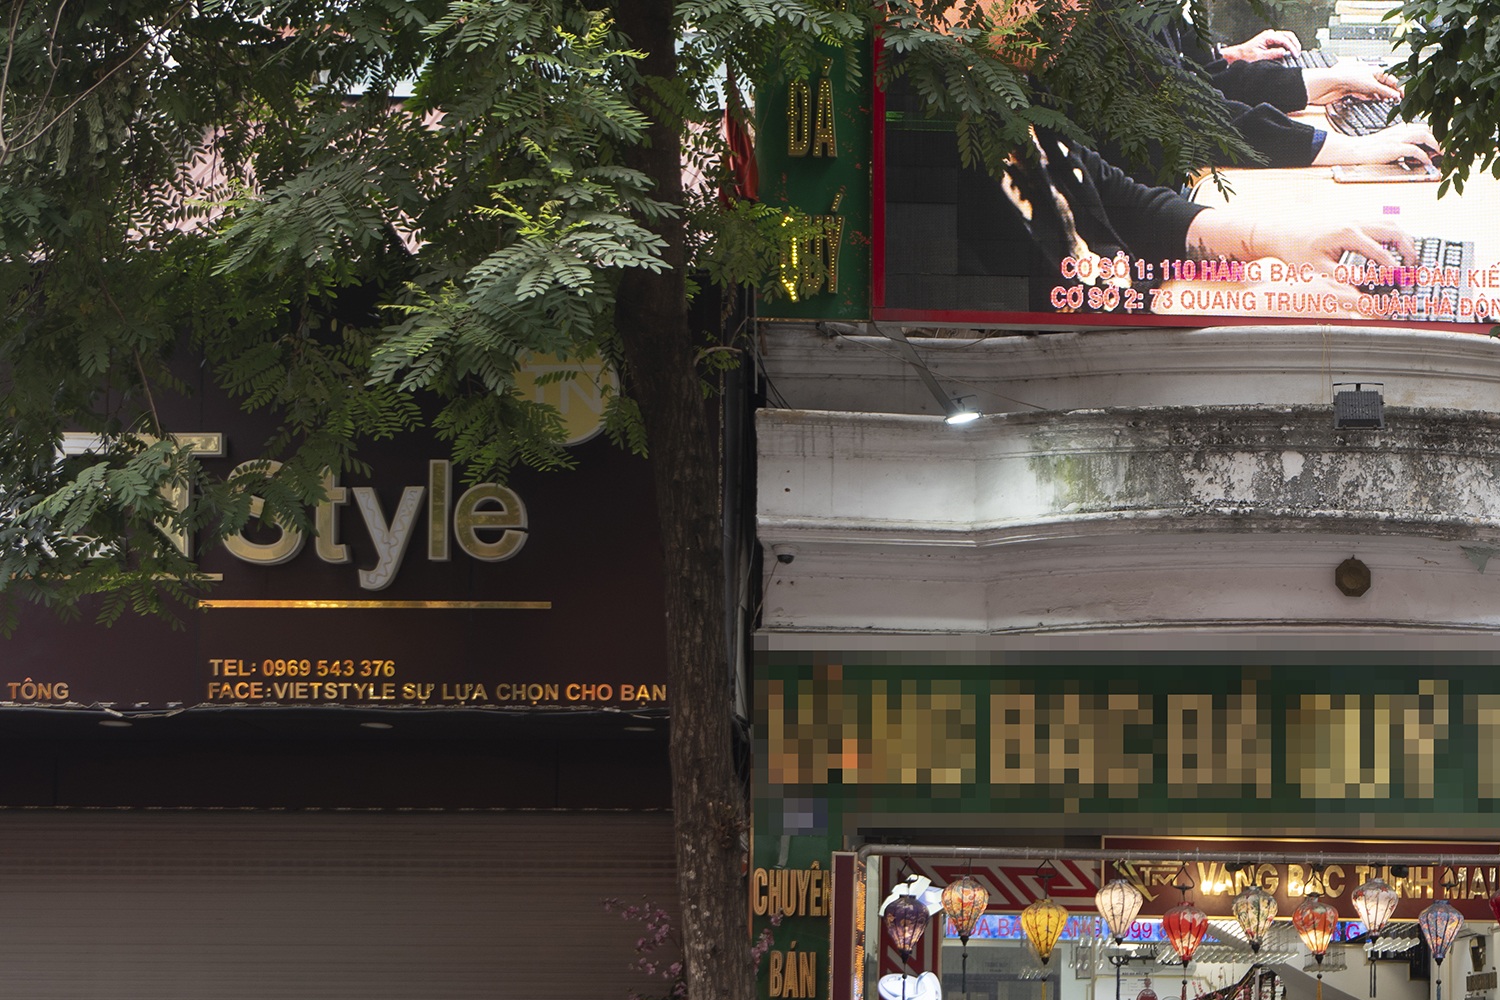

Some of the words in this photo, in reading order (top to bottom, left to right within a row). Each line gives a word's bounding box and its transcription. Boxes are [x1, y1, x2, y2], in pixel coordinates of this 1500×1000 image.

[787, 57, 838, 158] ĐÁ
[1061, 256, 1095, 280] CƠ
[1100, 250, 1131, 279] SỞ
[1134, 258, 1154, 280] 1:
[1160, 259, 1197, 281] 110
[1201, 255, 1263, 283] HÀNG
[1270, 263, 1315, 287] BẠC
[1334, 260, 1395, 290] QUẬN
[1402, 261, 1460, 288] HOÀN
[1051, 284, 1085, 309] CƠ
[1088, 280, 1121, 309] SỞ
[1124, 288, 1144, 309] 2:
[1150, 288, 1174, 310] 73
[1180, 290, 1257, 312] QUANG
[1264, 291, 1339, 314] TRUNG
[1357, 292, 1417, 320] QUẬN
[1424, 290, 1452, 316] HÀ
[209, 659, 258, 677] TEL:
[263, 659, 311, 678] 0969
[317, 659, 356, 678] 543
[360, 659, 396, 678] 376
[7, 678, 69, 701] TÔNG
[402, 680, 435, 705] SỰ
[442, 680, 488, 705] LỰA
[496, 683, 560, 706] CHỌN
[565, 684, 614, 701] CHO
[619, 683, 668, 707] BẠN
[753, 860, 832, 917] CHUYÊN
[769, 941, 818, 999] BÁN
